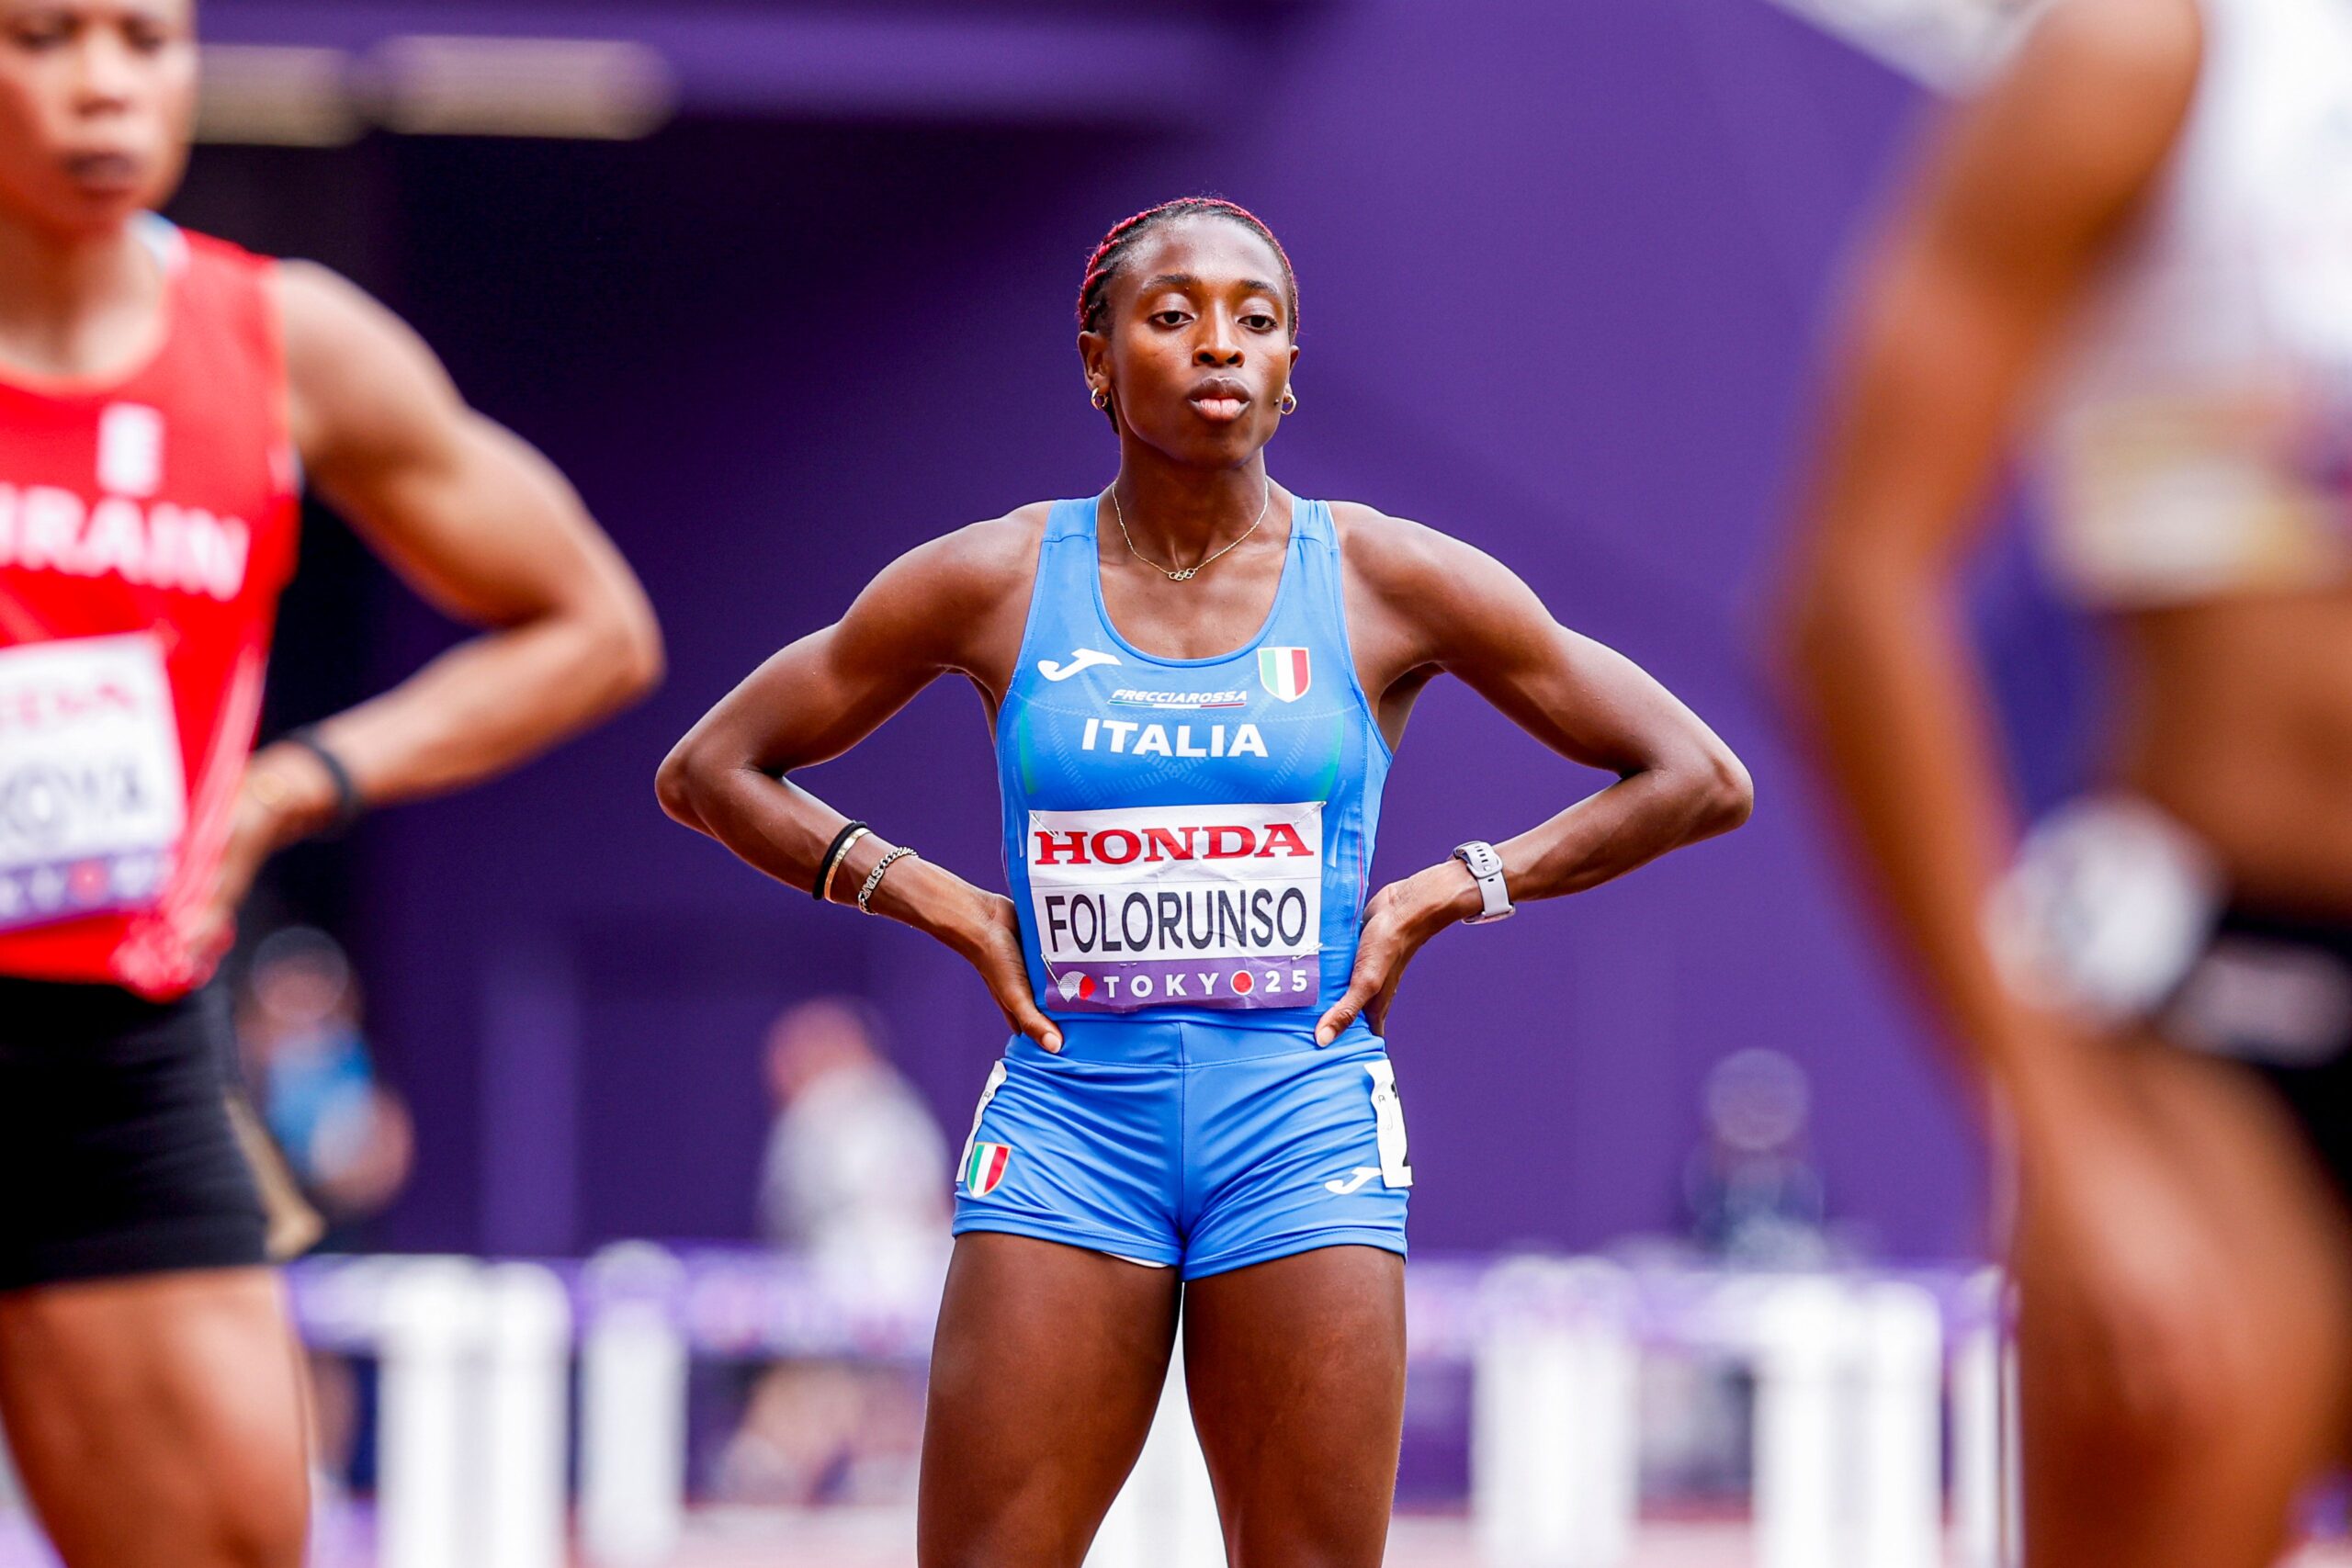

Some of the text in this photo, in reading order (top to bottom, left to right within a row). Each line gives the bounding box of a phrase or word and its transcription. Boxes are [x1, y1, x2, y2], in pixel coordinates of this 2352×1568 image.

[1111, 688, 1248, 704] FRECCIAROSSA
[1081, 718, 1269, 758] ITALIA
[1034, 823, 1315, 865] HONDA
[1045, 886, 1306, 953] FOLORUNSO
[1264, 969, 1308, 993] 25
